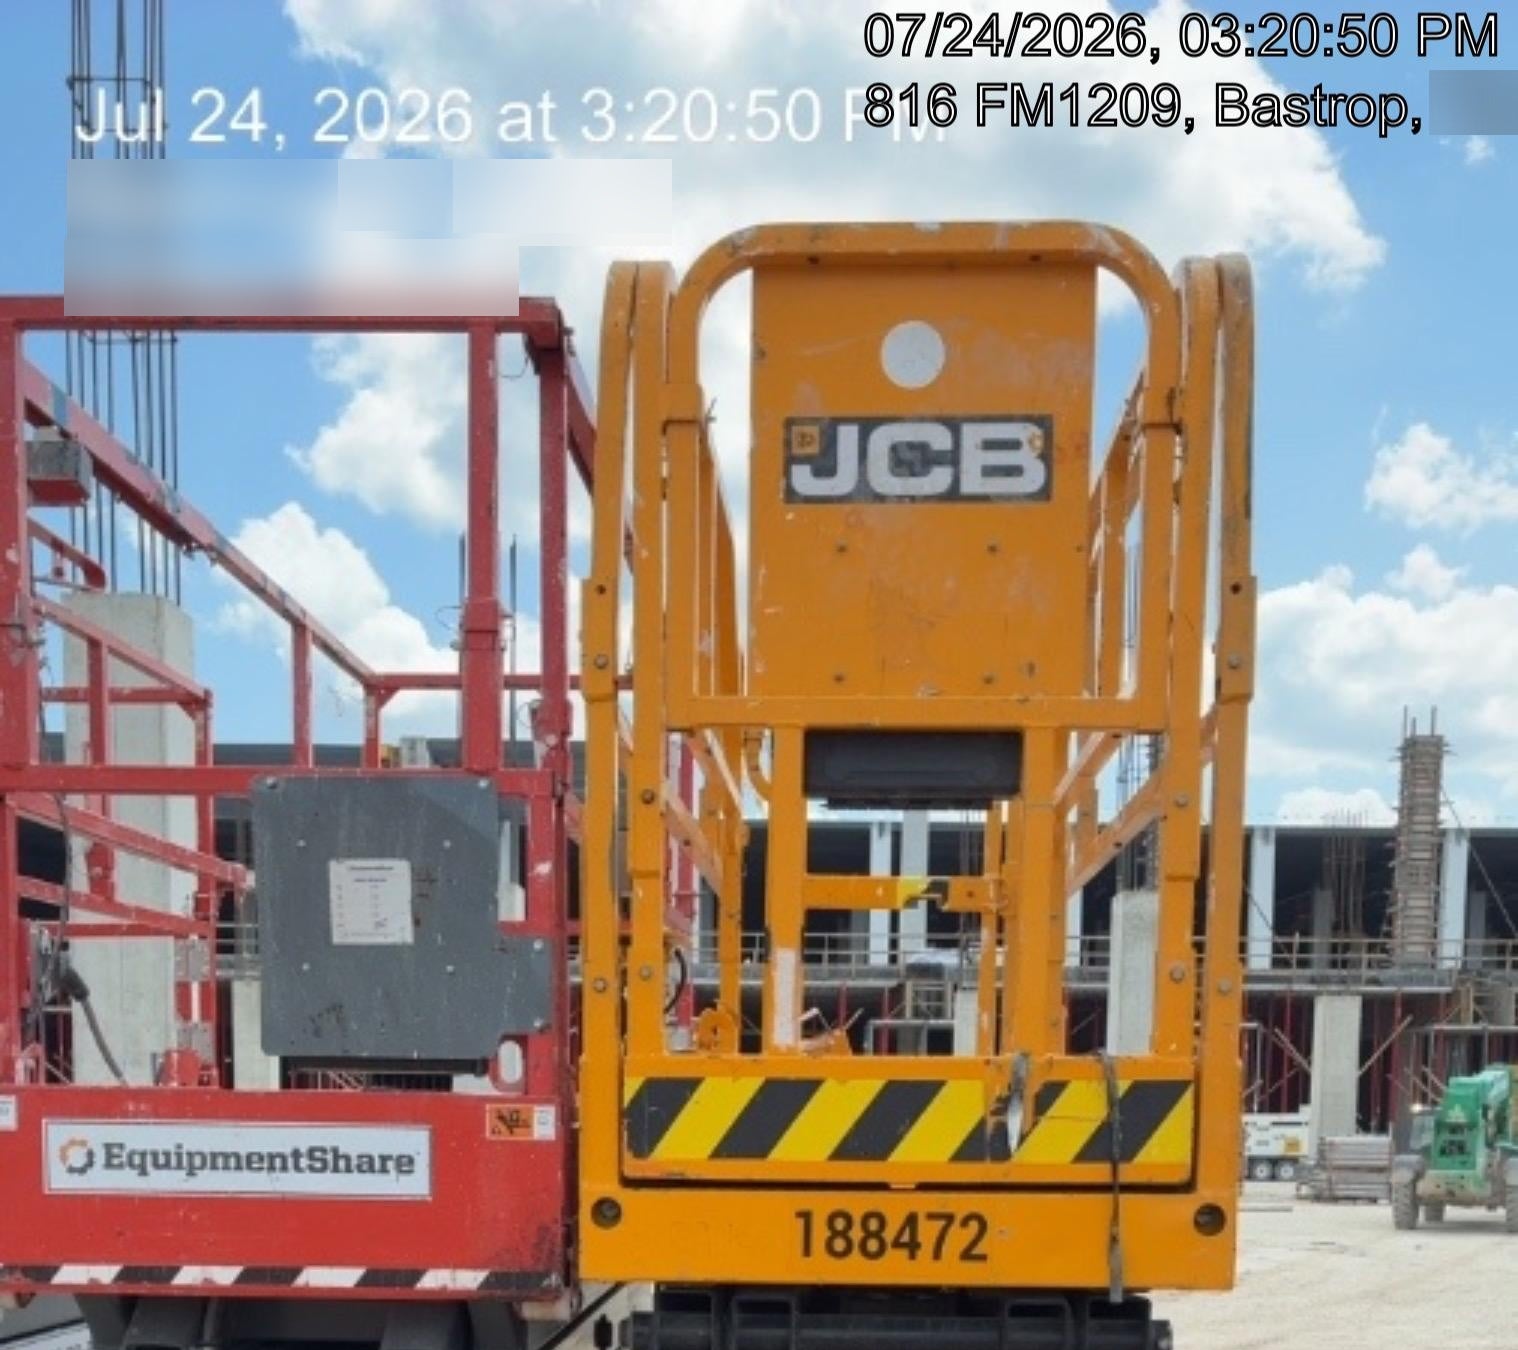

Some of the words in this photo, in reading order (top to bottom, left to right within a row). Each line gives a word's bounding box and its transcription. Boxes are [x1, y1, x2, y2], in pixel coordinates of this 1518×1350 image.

[790, 422, 1046, 497] JCB
[103, 1142, 416, 1176] EquipmentShare
[795, 1209, 989, 1262] 188472
